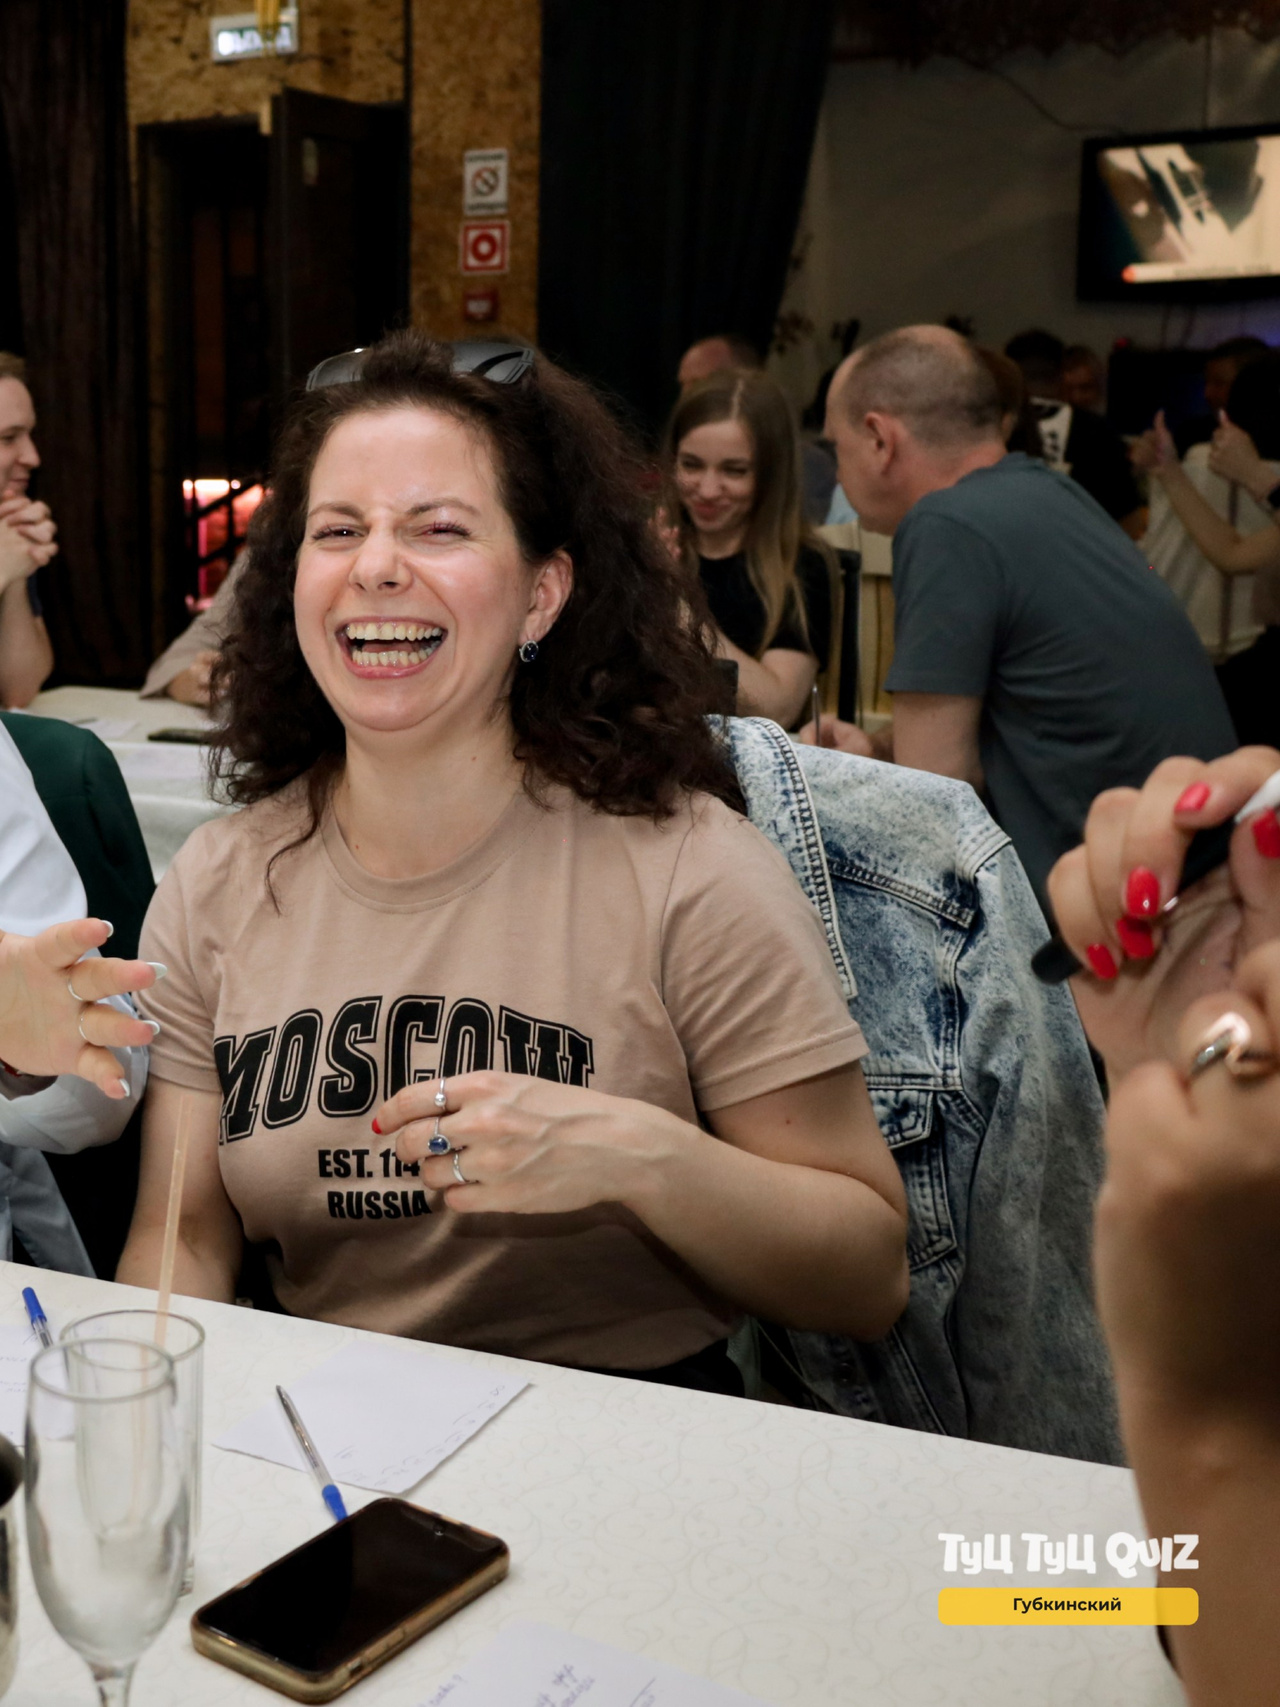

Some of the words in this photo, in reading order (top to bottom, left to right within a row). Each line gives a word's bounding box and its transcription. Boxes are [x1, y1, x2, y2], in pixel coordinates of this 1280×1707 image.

[214, 995, 594, 1145] MOSCOW
[318, 1149, 373, 1178] EST.
[327, 1190, 432, 1219] RUSSIA
